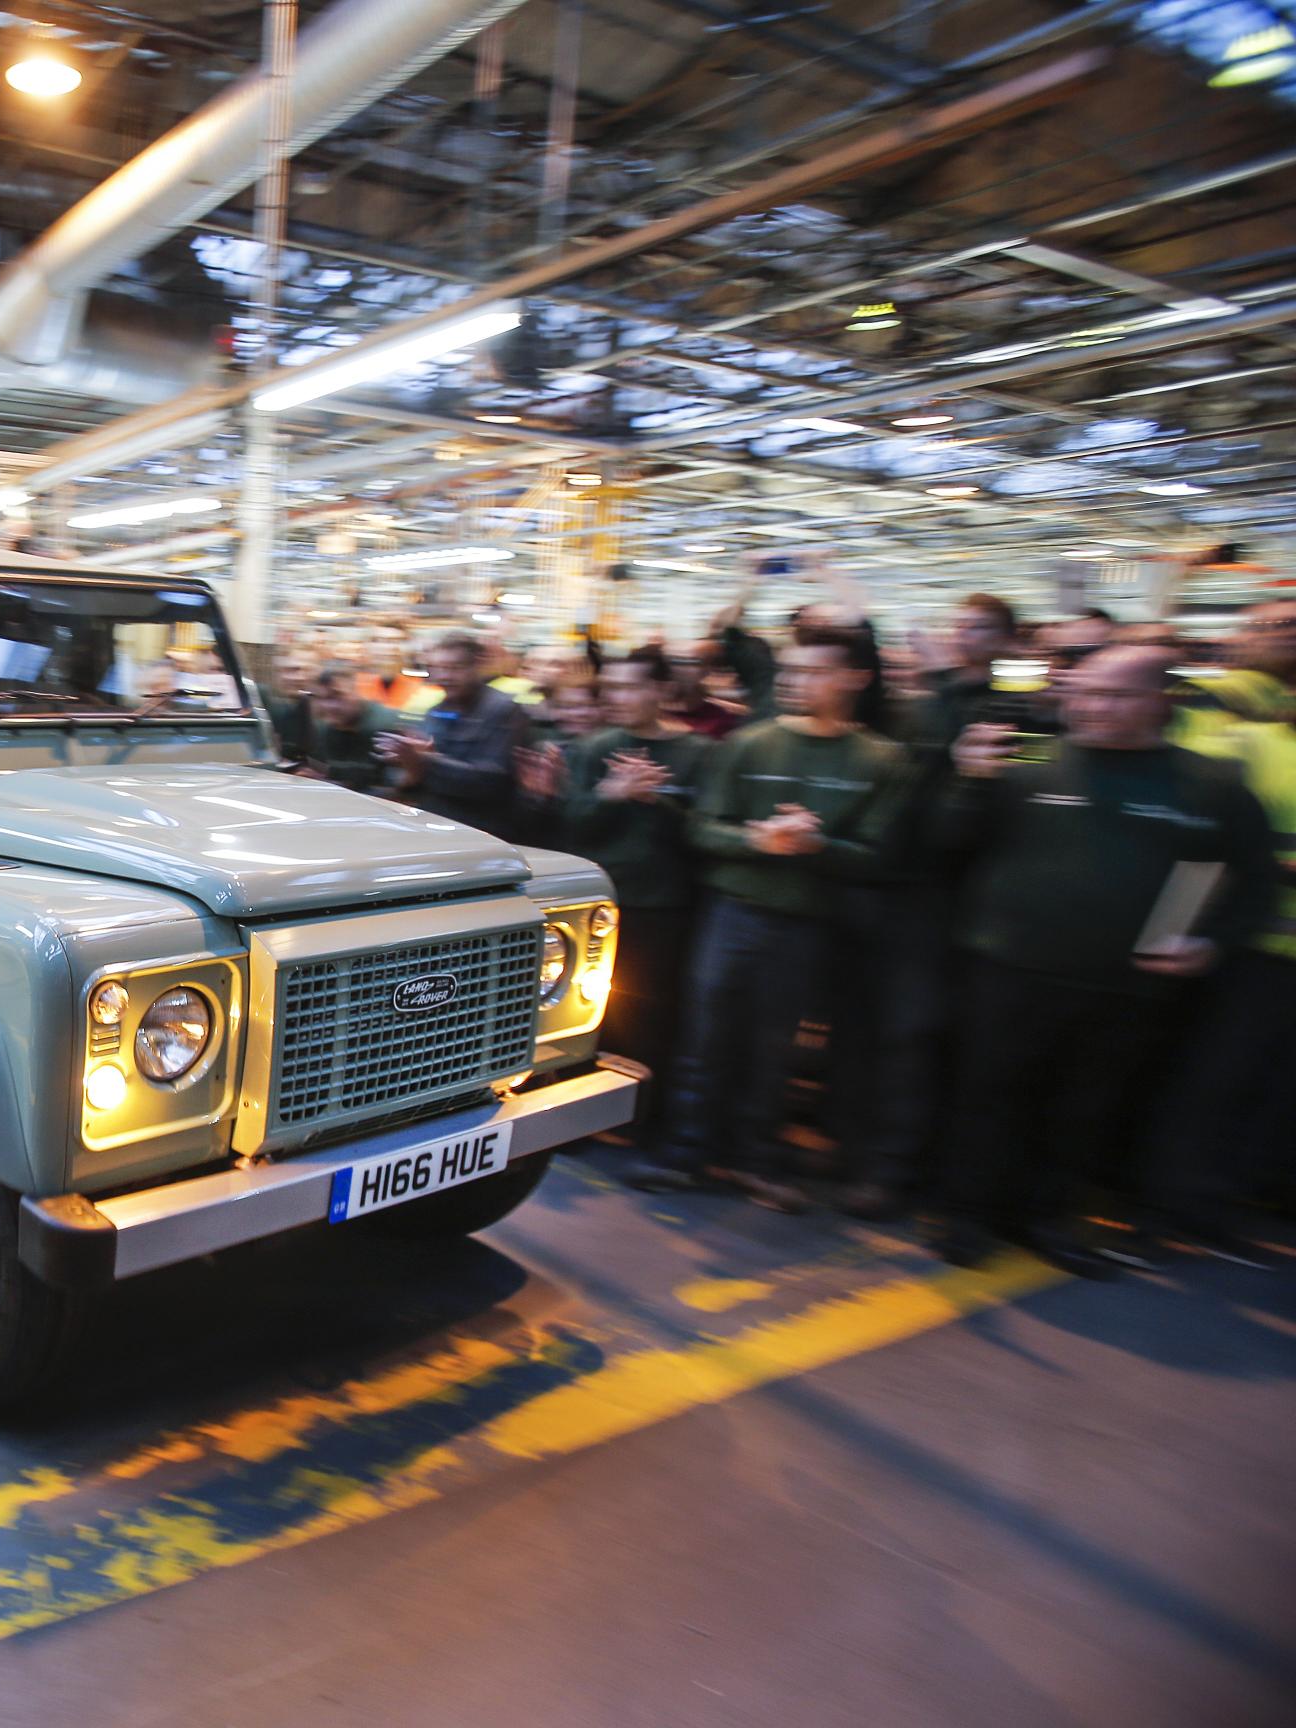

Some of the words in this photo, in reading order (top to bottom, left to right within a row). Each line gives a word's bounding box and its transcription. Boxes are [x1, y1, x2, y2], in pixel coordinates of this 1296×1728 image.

[403, 981, 430, 995] LAND
[417, 990, 449, 1005] ROVER
[439, 1132, 499, 1184] HUE
